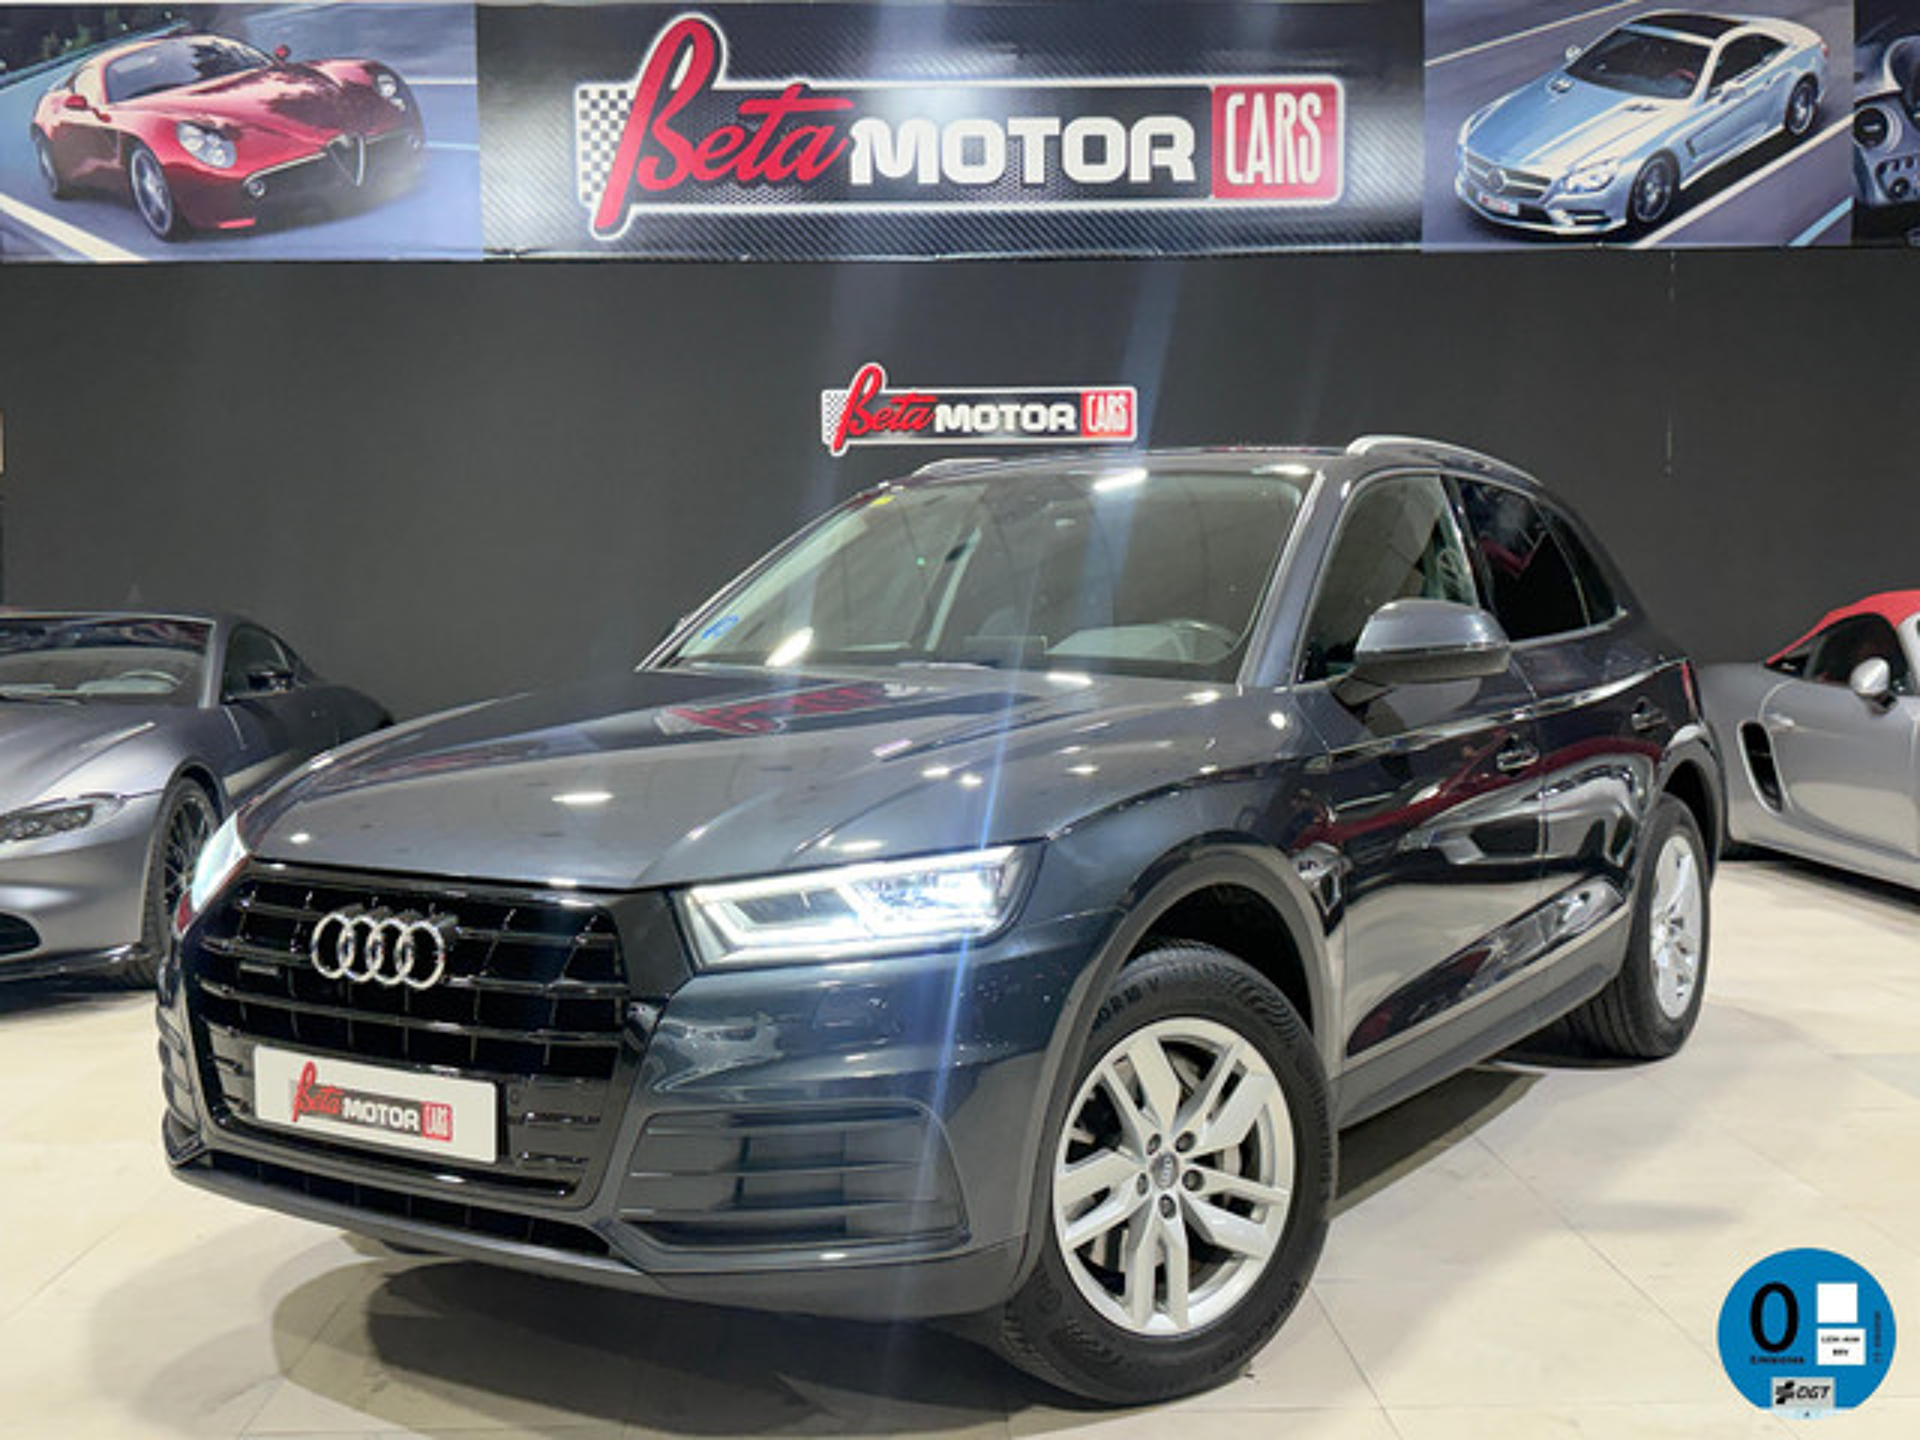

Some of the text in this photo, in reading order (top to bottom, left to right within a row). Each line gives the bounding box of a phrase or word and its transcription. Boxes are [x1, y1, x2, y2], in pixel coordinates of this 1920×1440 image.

[594, 16, 1325, 233] Beta MOTOR CARS
[832, 364, 1128, 452] Beta MOTOR CARS
[291, 1061, 343, 1122] Beta
[342, 1097, 420, 1132] MOTOR
